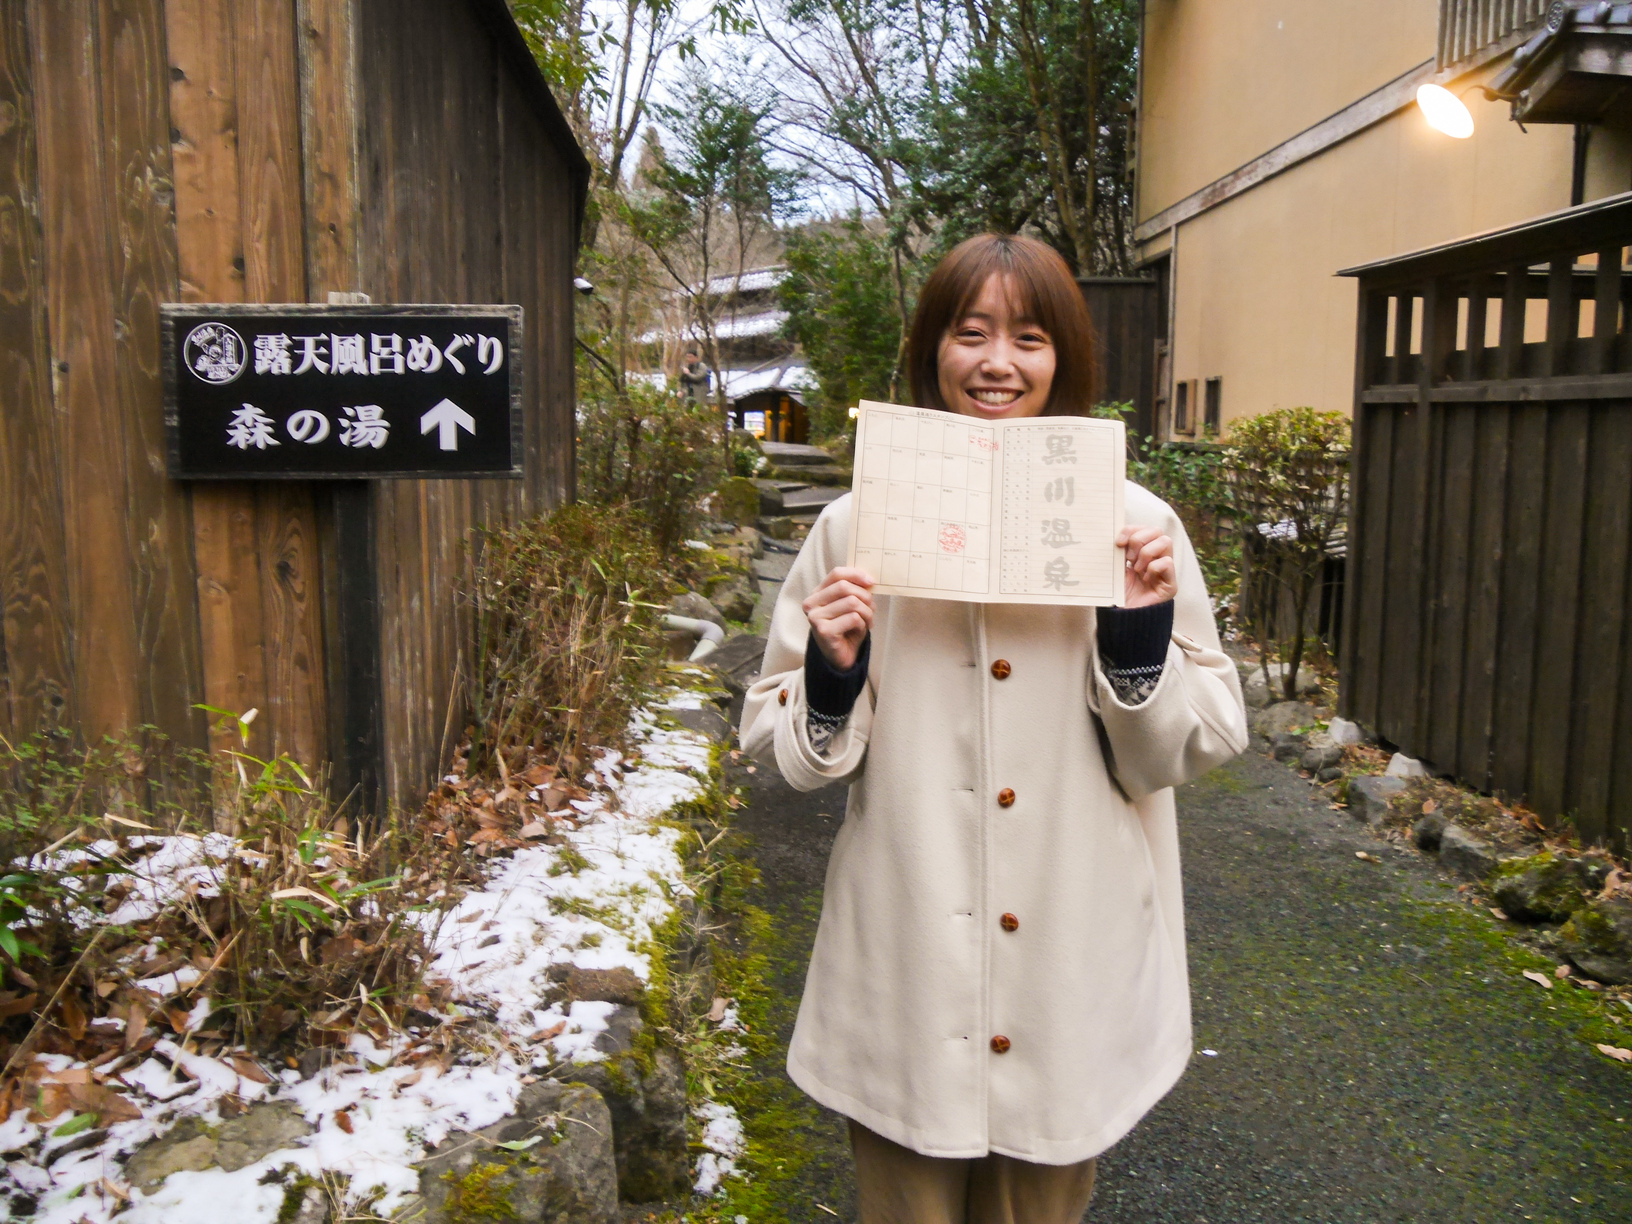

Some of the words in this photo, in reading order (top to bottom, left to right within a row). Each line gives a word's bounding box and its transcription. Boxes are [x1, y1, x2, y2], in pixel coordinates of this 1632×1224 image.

[254, 333, 504, 376] 露天風呂めぐり
[226, 403, 392, 451] 森の湯
[1041, 434, 1082, 592] 黒川温泉
